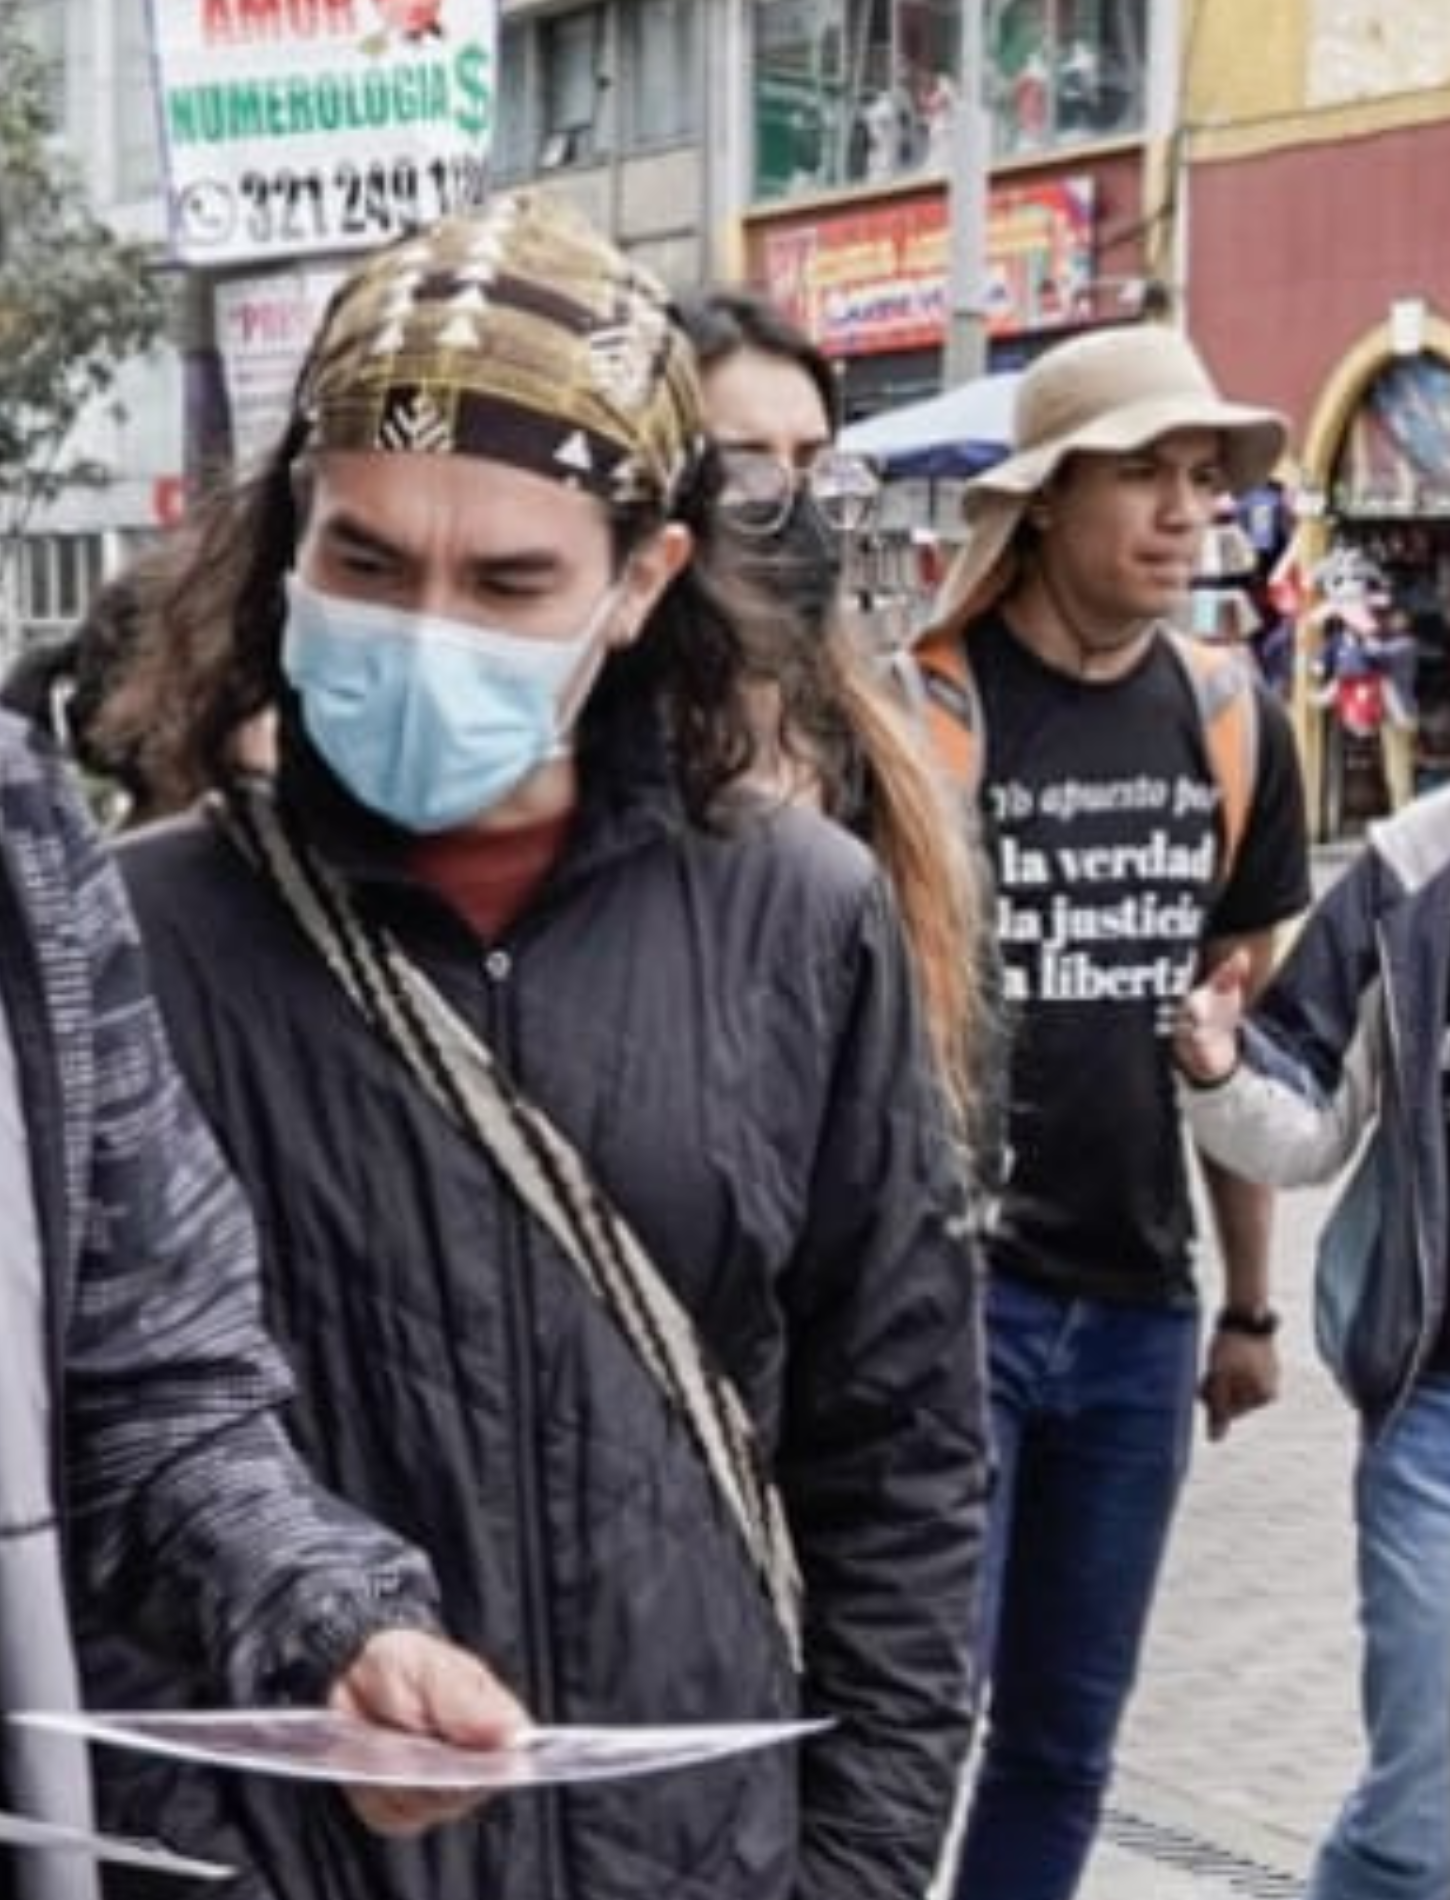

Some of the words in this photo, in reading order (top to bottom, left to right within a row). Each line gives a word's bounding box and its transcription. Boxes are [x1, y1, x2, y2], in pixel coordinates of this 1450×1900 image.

[1038, 776, 1170, 824] apuesto
[1002, 835, 1050, 884] la
[1056, 827, 1216, 882] verdad
[998, 894, 1042, 942] la
